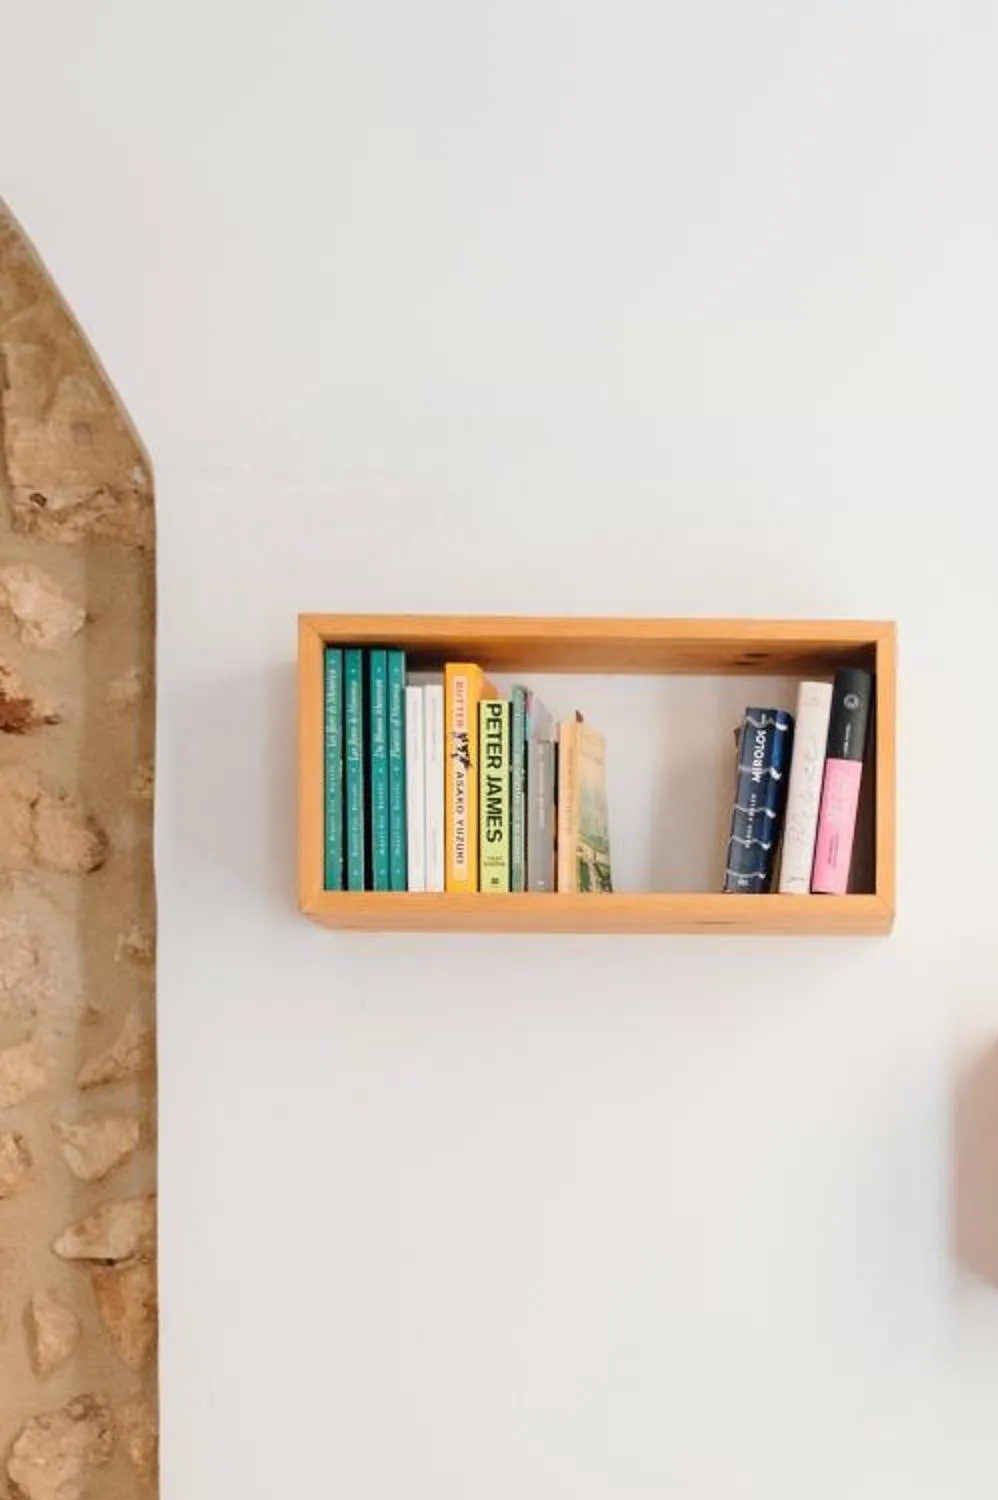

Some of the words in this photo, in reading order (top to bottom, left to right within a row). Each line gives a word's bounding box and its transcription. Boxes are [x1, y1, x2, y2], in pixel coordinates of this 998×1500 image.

[486, 704, 502, 768] PETER
[455, 771, 465, 814] ASAKO
[485, 774, 503, 843] JAMES
[455, 817, 465, 865] YUZUKI
